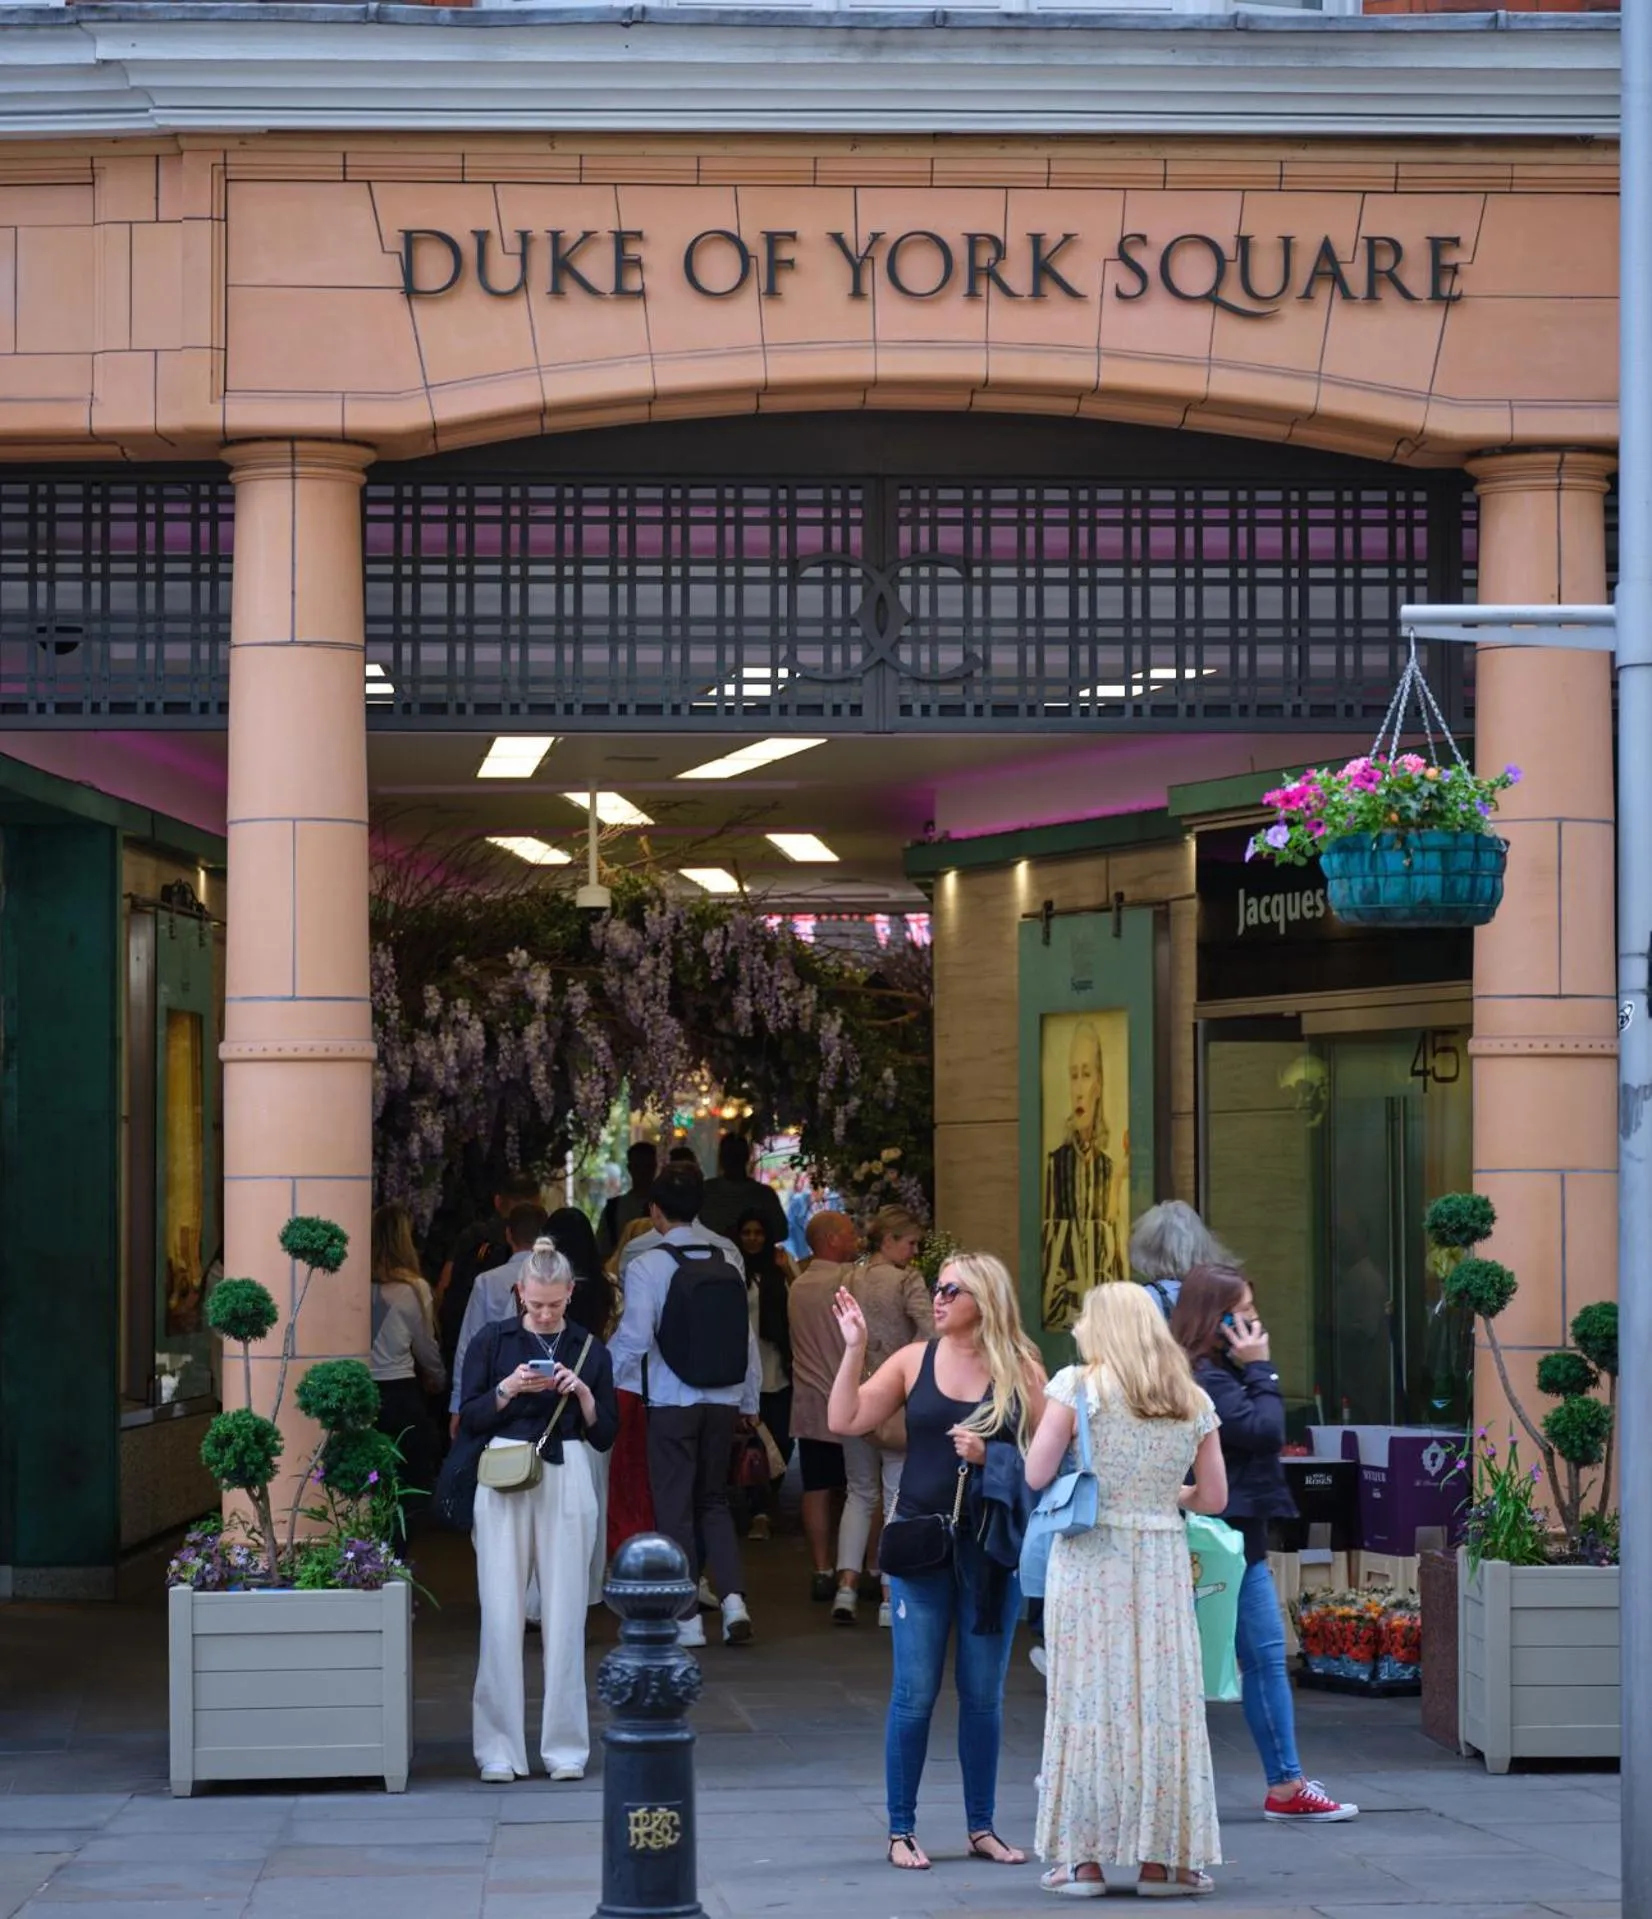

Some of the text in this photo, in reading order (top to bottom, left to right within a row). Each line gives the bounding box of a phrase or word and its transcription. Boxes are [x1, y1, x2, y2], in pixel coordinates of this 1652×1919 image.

[397, 228, 1463, 319] DUKE OF YORK SQUARE
[1237, 887, 1326, 936] Jacques
[1410, 1029, 1460, 1094] 45
